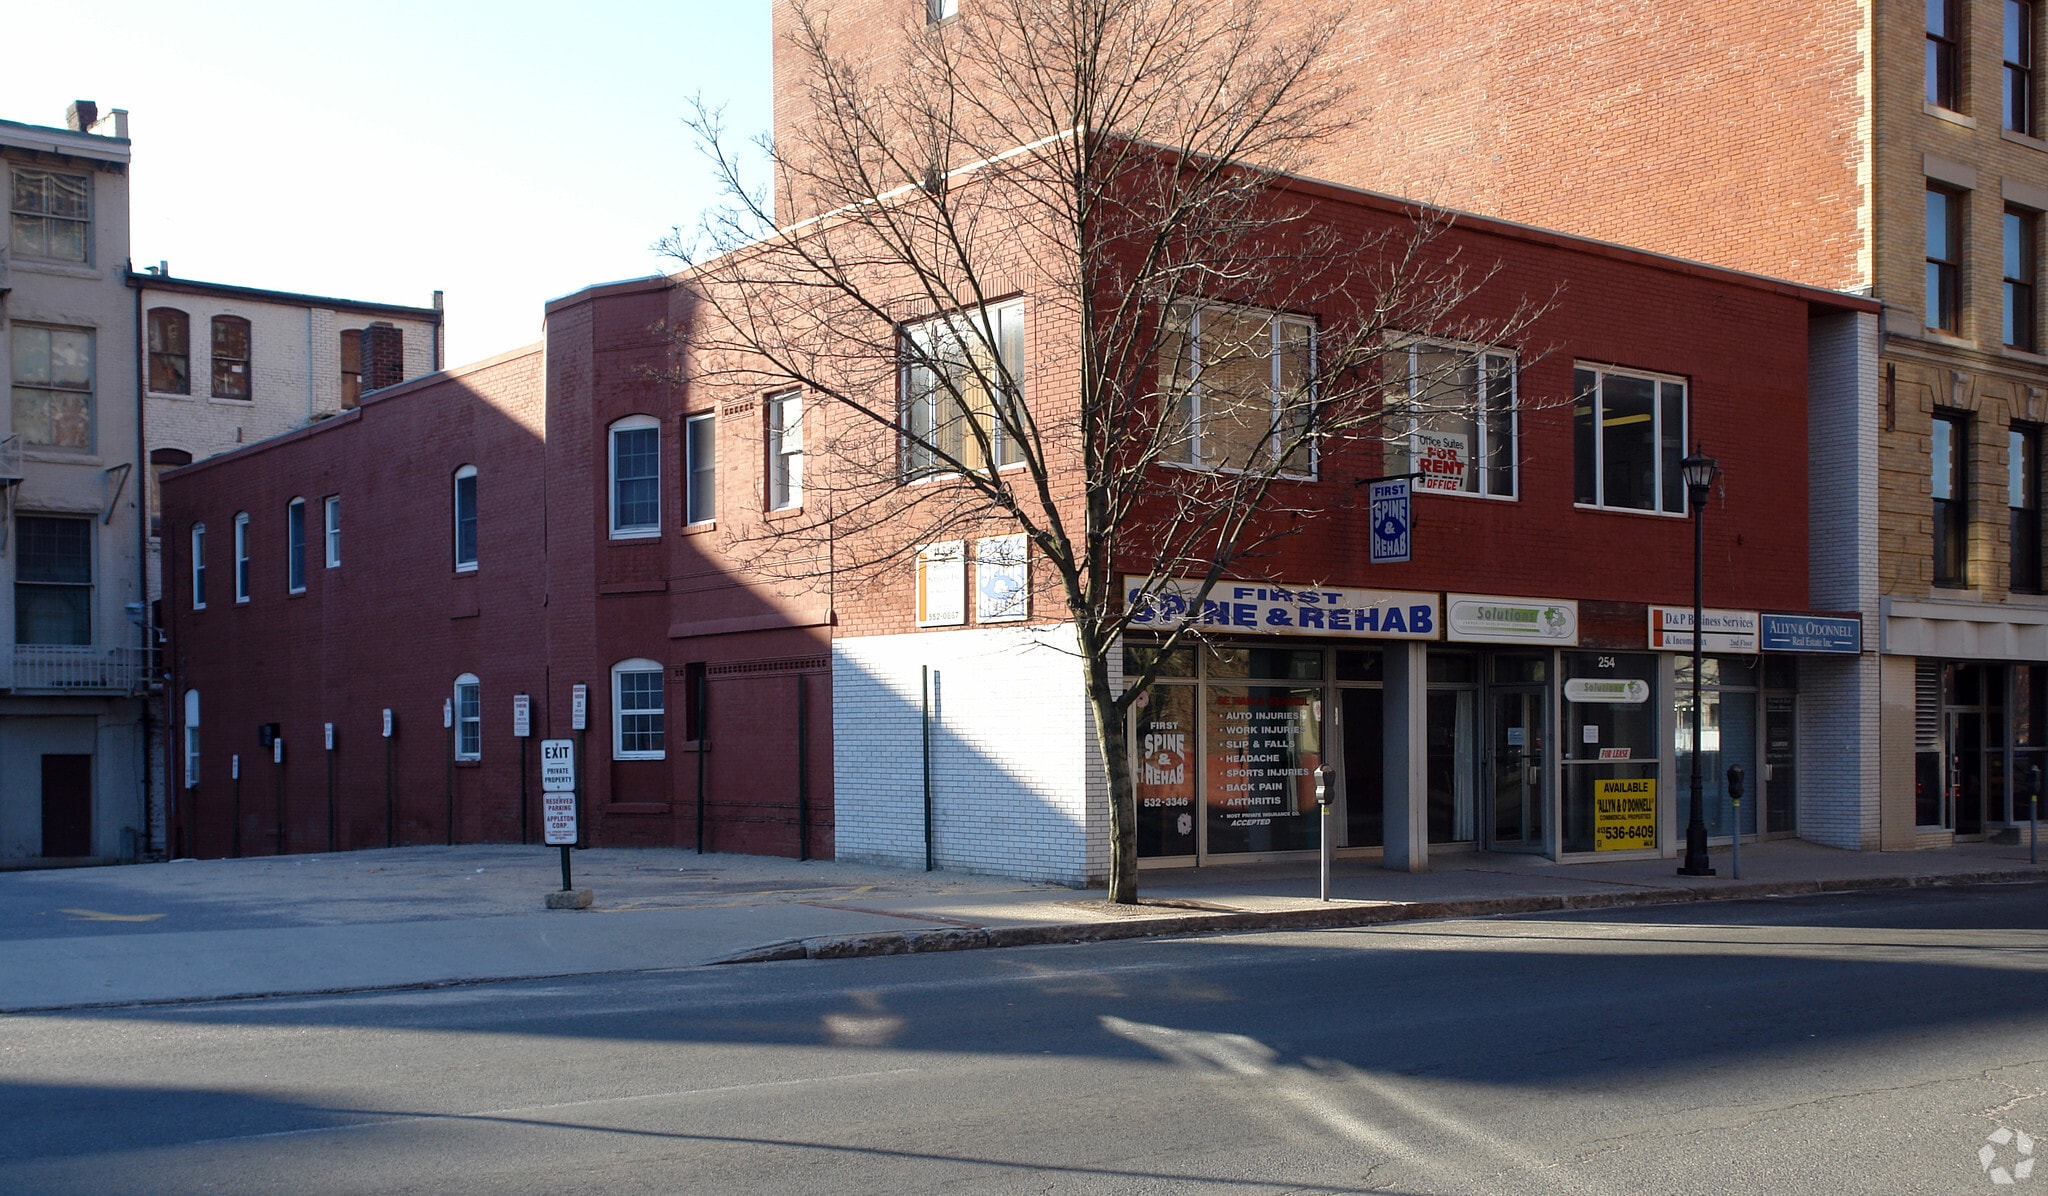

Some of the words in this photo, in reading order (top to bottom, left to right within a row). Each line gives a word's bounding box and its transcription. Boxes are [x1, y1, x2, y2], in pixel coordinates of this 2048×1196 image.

[1443, 437, 1465, 450] Suites
[1427, 447, 1457, 461] FOR
[1420, 458, 1464, 475] RENT
[1427, 478, 1458, 491] OFFICE
[1375, 485, 1405, 497] FIRST
[1375, 499, 1406, 529] SPINE
[1384, 521, 1396, 534] &
[1375, 531, 1406, 557] REHAB
[1233, 587, 1343, 605] FIRST
[1266, 607, 1295, 627] &
[1299, 604, 1433, 634] REHAB
[1477, 606, 1535, 622] Solutions
[1688, 613, 1721, 626] Biness
[1722, 615, 1754, 629] Services
[1769, 620, 1798, 634] ALLYN
[1798, 624, 1804, 635] &
[1665, 635, 1671, 645] &
[1673, 635, 1695, 645] Incom
[1792, 636, 1805, 646] Real
[1806, 637, 1822, 647] Estate
[1598, 656, 1615, 668] 254
[1226, 711, 1253, 720] AUTO
[1255, 711, 1300, 720] INJURIES
[1150, 721, 1179, 730] FIRST
[1226, 726, 1258, 735] WORK
[1261, 725, 1307, 734] INJURIES
[1144, 733, 1185, 760] SPINE
[1226, 740, 1250, 749] SLIP
[1252, 740, 1260, 749] &
[1264, 740, 1296, 748] FALLS
[545, 746, 570, 759] EXIT
[1225, 754, 1280, 763] HEADACHE
[1601, 749, 1612, 758] FOR
[1612, 749, 1629, 758] LEASE
[1158, 753, 1172, 765] &
[547, 767, 569, 775] PRIVATE
[1145, 763, 1185, 785] REHAB
[1226, 768, 1265, 778] SPORTS
[1267, 768, 1309, 777] INJURIES
[544, 776, 572, 784] PROPERTY
[1226, 783, 1256, 792] BACK
[1258, 782, 1283, 791] PAIN
[1604, 782, 1648, 793] AVAILABLE
[1143, 797, 1188, 807] 532-3346
[1227, 796, 1281, 806] ARTHRITIS
[548, 804, 572, 812] PARKING
[1231, 818, 1271, 827] ACCEPTED
[1605, 824, 1654, 840] 536-6409
